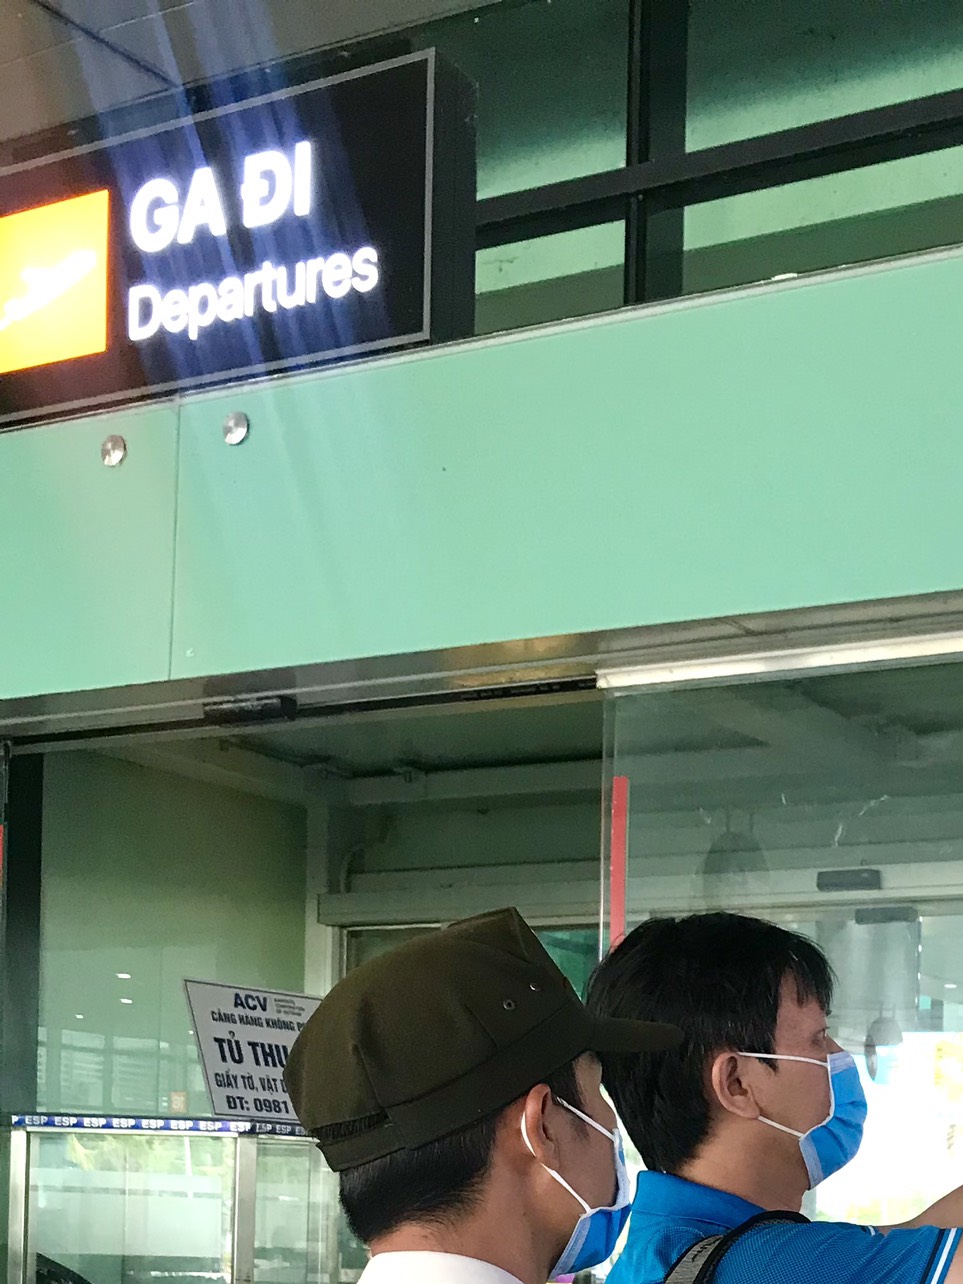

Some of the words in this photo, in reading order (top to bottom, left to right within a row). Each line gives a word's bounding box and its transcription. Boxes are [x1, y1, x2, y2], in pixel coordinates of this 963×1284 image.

[130, 166, 227, 253] GA
[241, 141, 312, 228] ĐI
[128, 247, 379, 341] Departures
[234, 993, 267, 1012] ACV
[214, 1031, 244, 1064] TỦ
